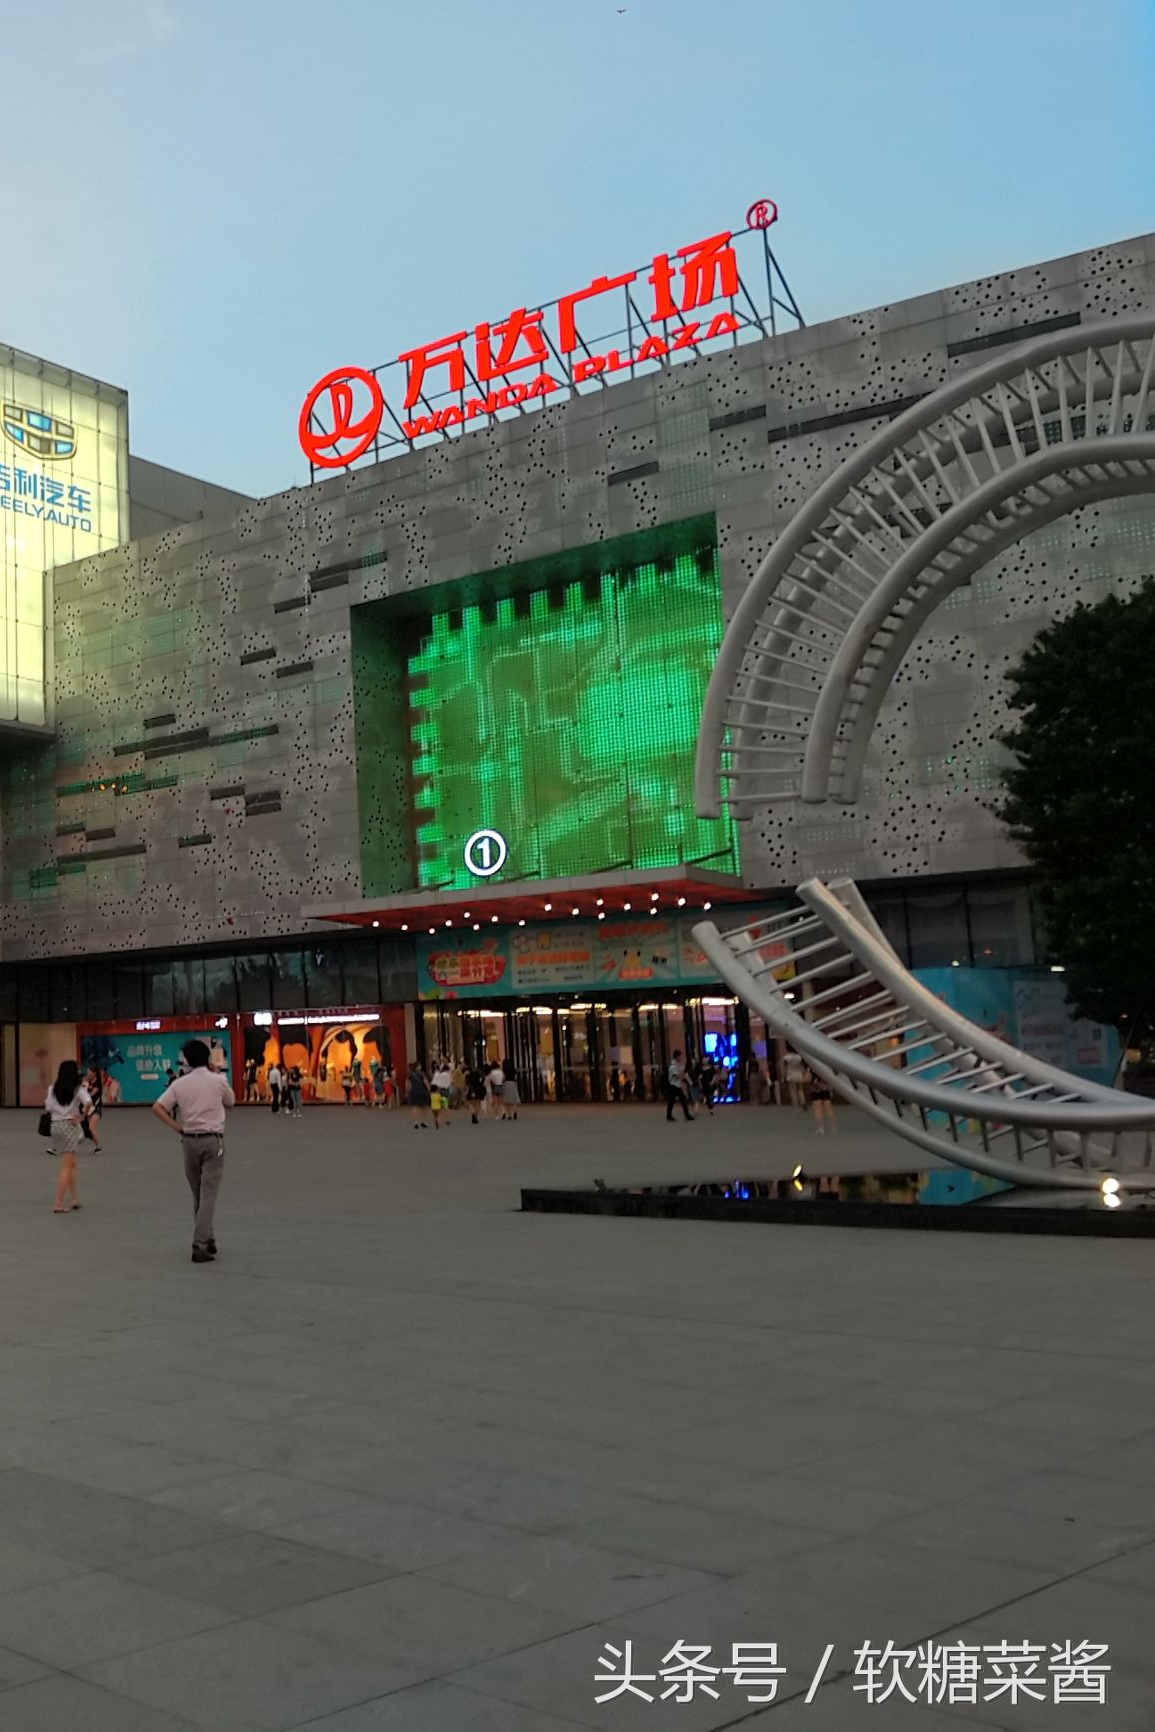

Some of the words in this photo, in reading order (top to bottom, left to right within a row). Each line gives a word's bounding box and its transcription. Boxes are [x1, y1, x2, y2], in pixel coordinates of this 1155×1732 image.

[398, 230, 739, 410] 万达广场
[402, 372, 558, 439] WANDA
[573, 311, 740, 384] PLAZA
[45, 508, 92, 533] AUTO
